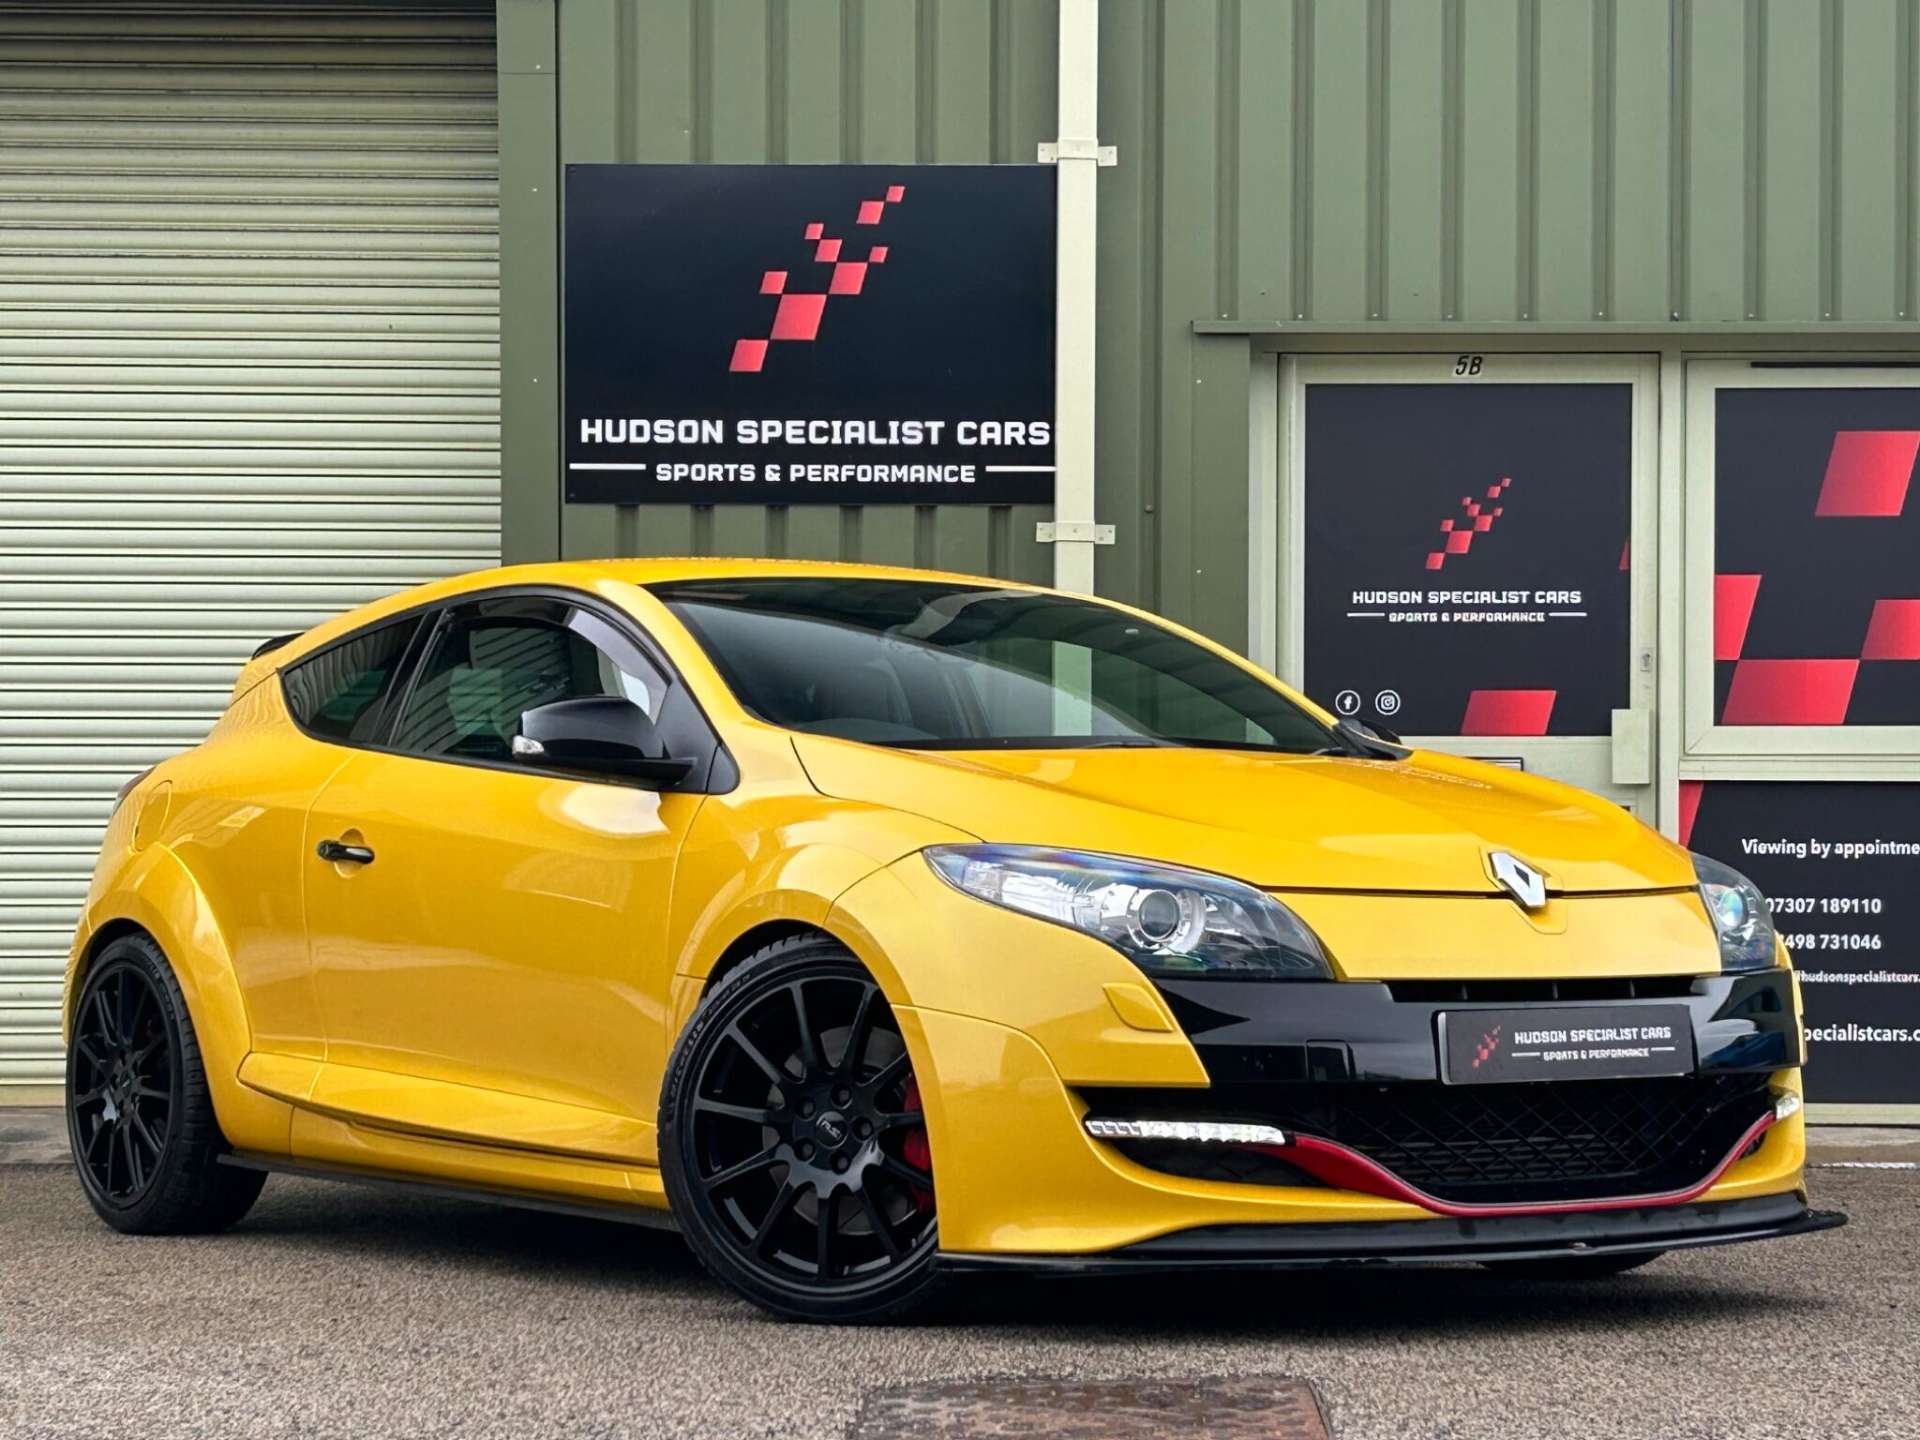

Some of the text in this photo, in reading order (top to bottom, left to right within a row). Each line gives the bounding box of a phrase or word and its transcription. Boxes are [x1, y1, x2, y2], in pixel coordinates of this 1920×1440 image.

[1455, 355, 1482, 375] 5B
[580, 418, 1051, 446] HUDSON SPECIALIST CARS
[655, 463, 976, 483] SPORTS & PERFORMANCE
[1352, 590, 1582, 604] HUDSON SPECIALIST CARS
[1388, 612, 1438, 623] SPORTS
[1453, 612, 1546, 623] PERFORMANCE
[1741, 838, 1807, 859] Viewing
[1810, 838, 1832, 860] by
[1819, 897, 1882, 914] 189110
[1780, 933, 1882, 950] 498 731046
[1514, 1026, 1672, 1045] HUDSON SPECIALIST CARS
[1542, 1050, 1579, 1062] SPORTS
[1588, 1047, 1650, 1060] PERFORMANCE
